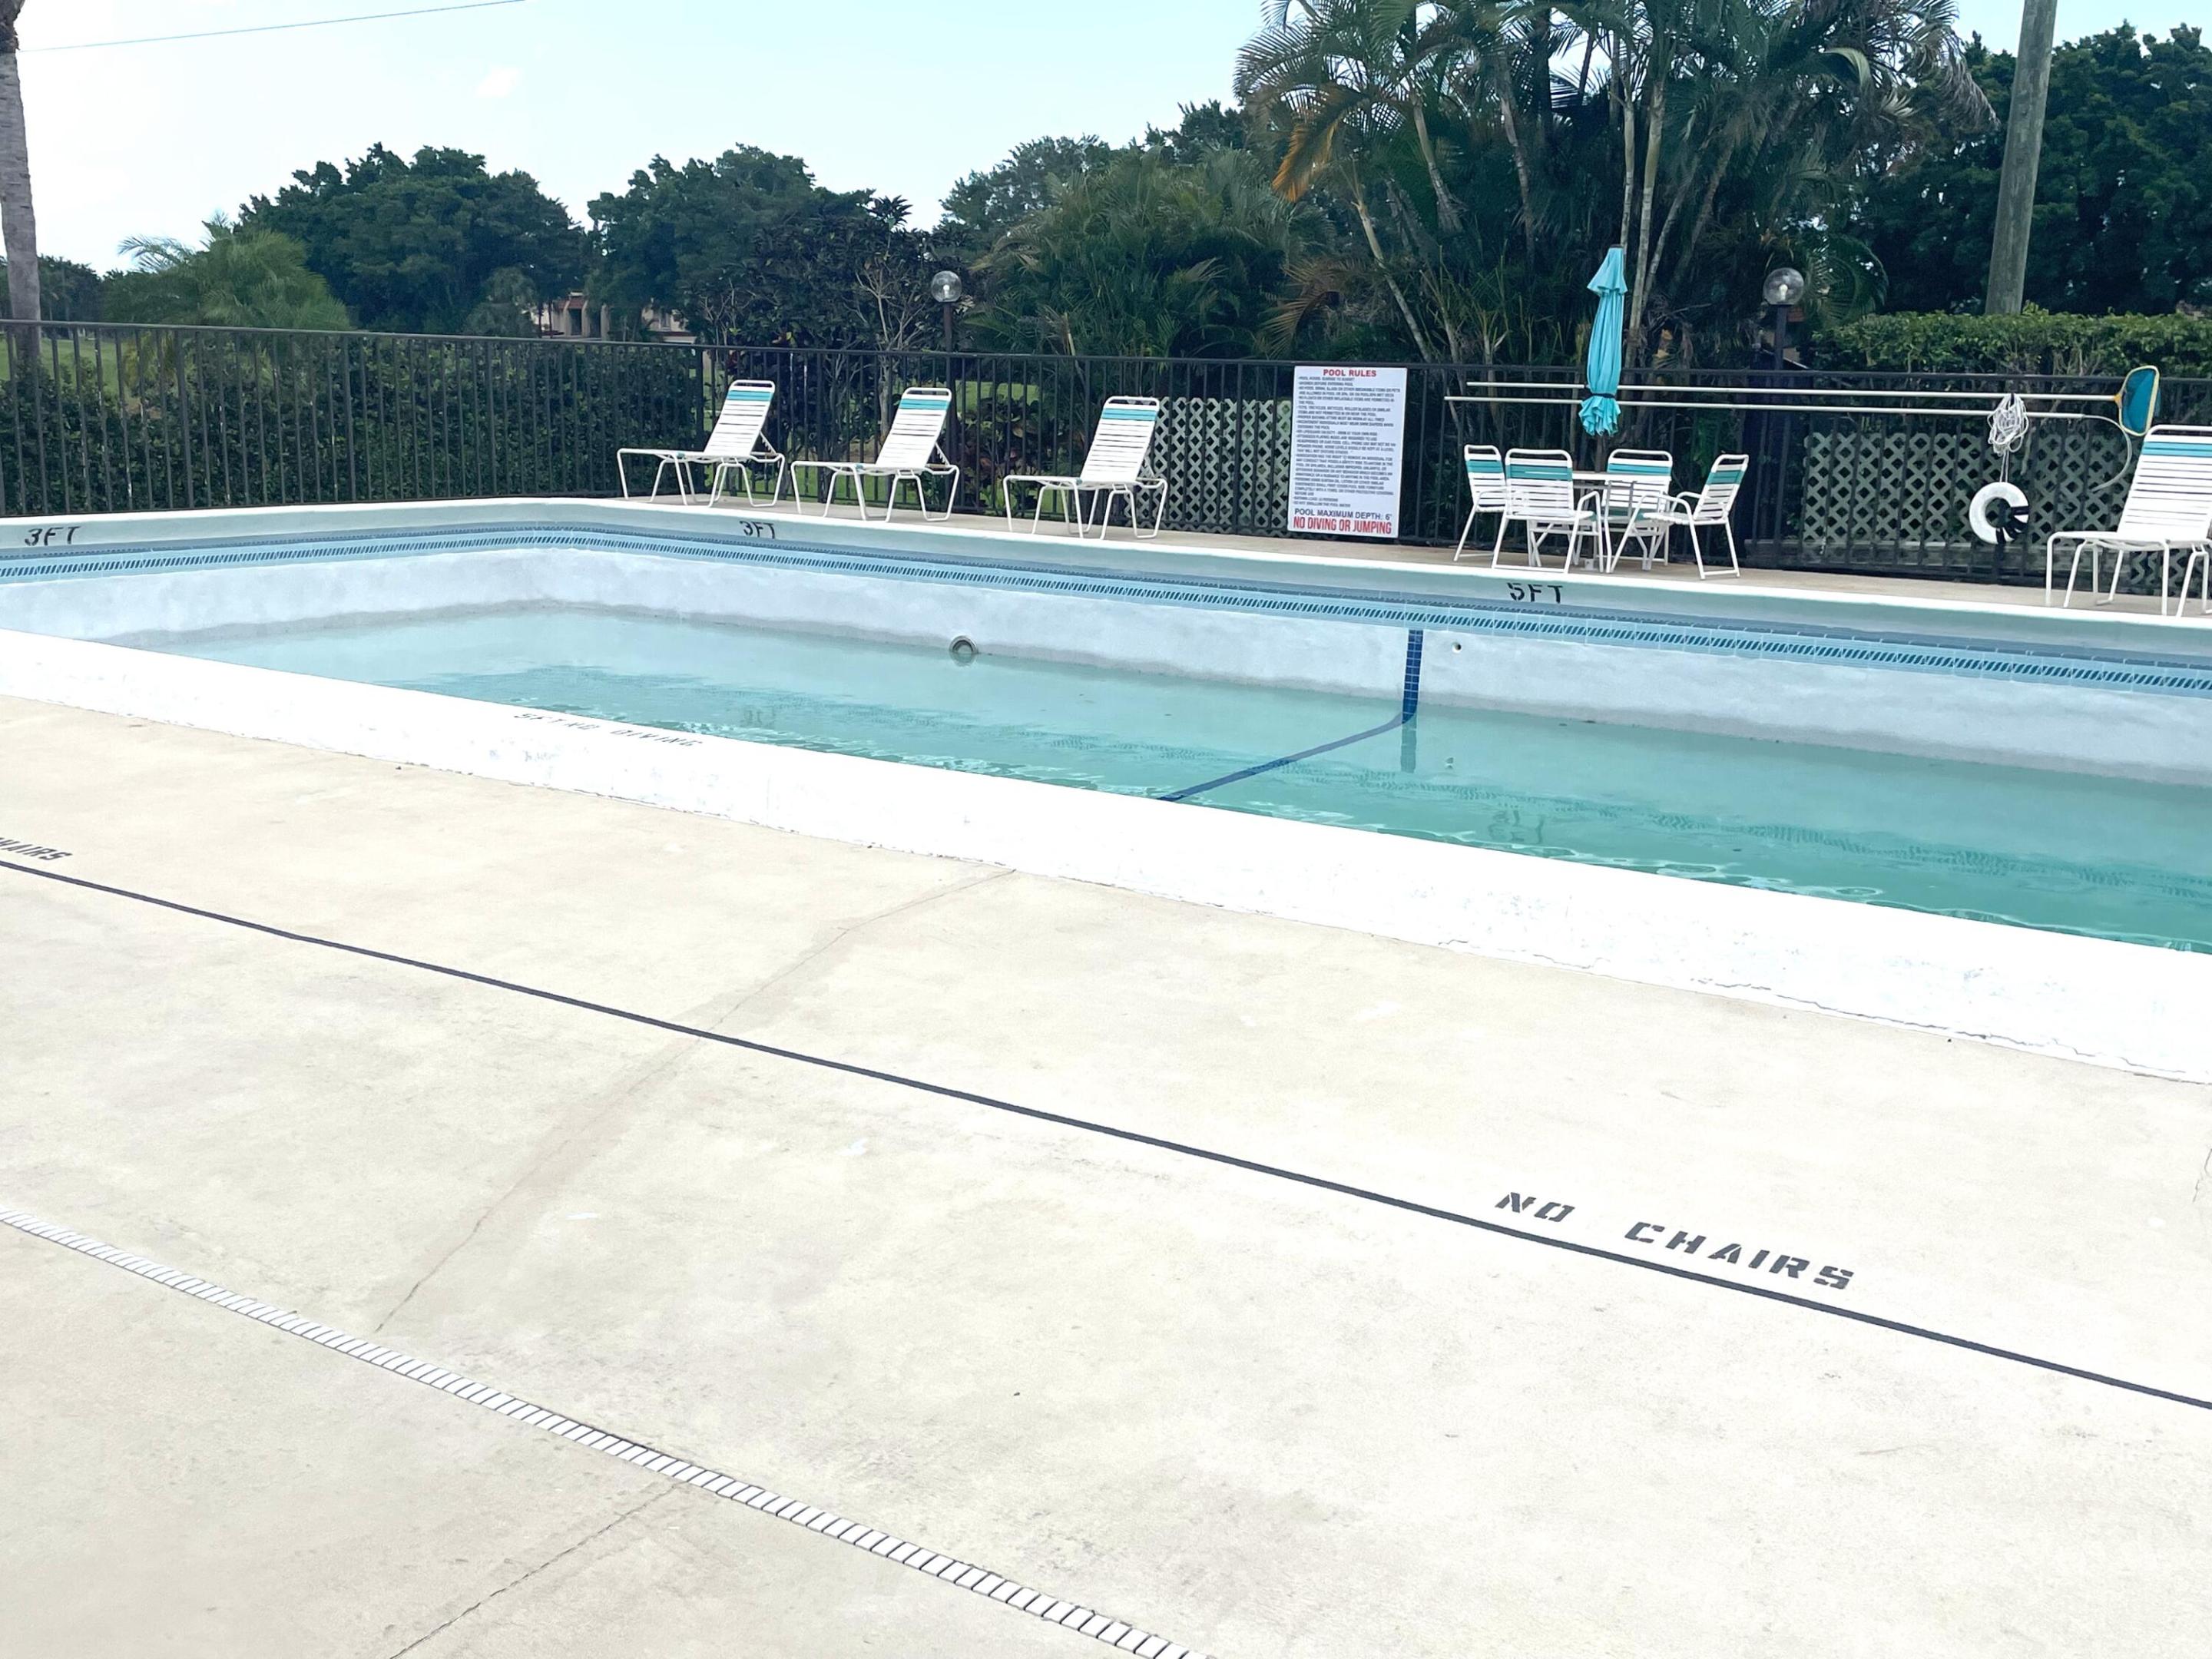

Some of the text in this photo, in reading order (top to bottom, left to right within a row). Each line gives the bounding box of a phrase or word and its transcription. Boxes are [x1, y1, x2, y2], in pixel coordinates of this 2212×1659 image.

[1294, 508, 1315, 516] POOL
[1316, 509, 1353, 518] MAXIMUM
[1293, 516, 1392, 534] NO DIVING OR JUMPING
[0, 837, 73, 860] HAIRS
[1495, 1191, 1854, 1290] NO CHAIRS
